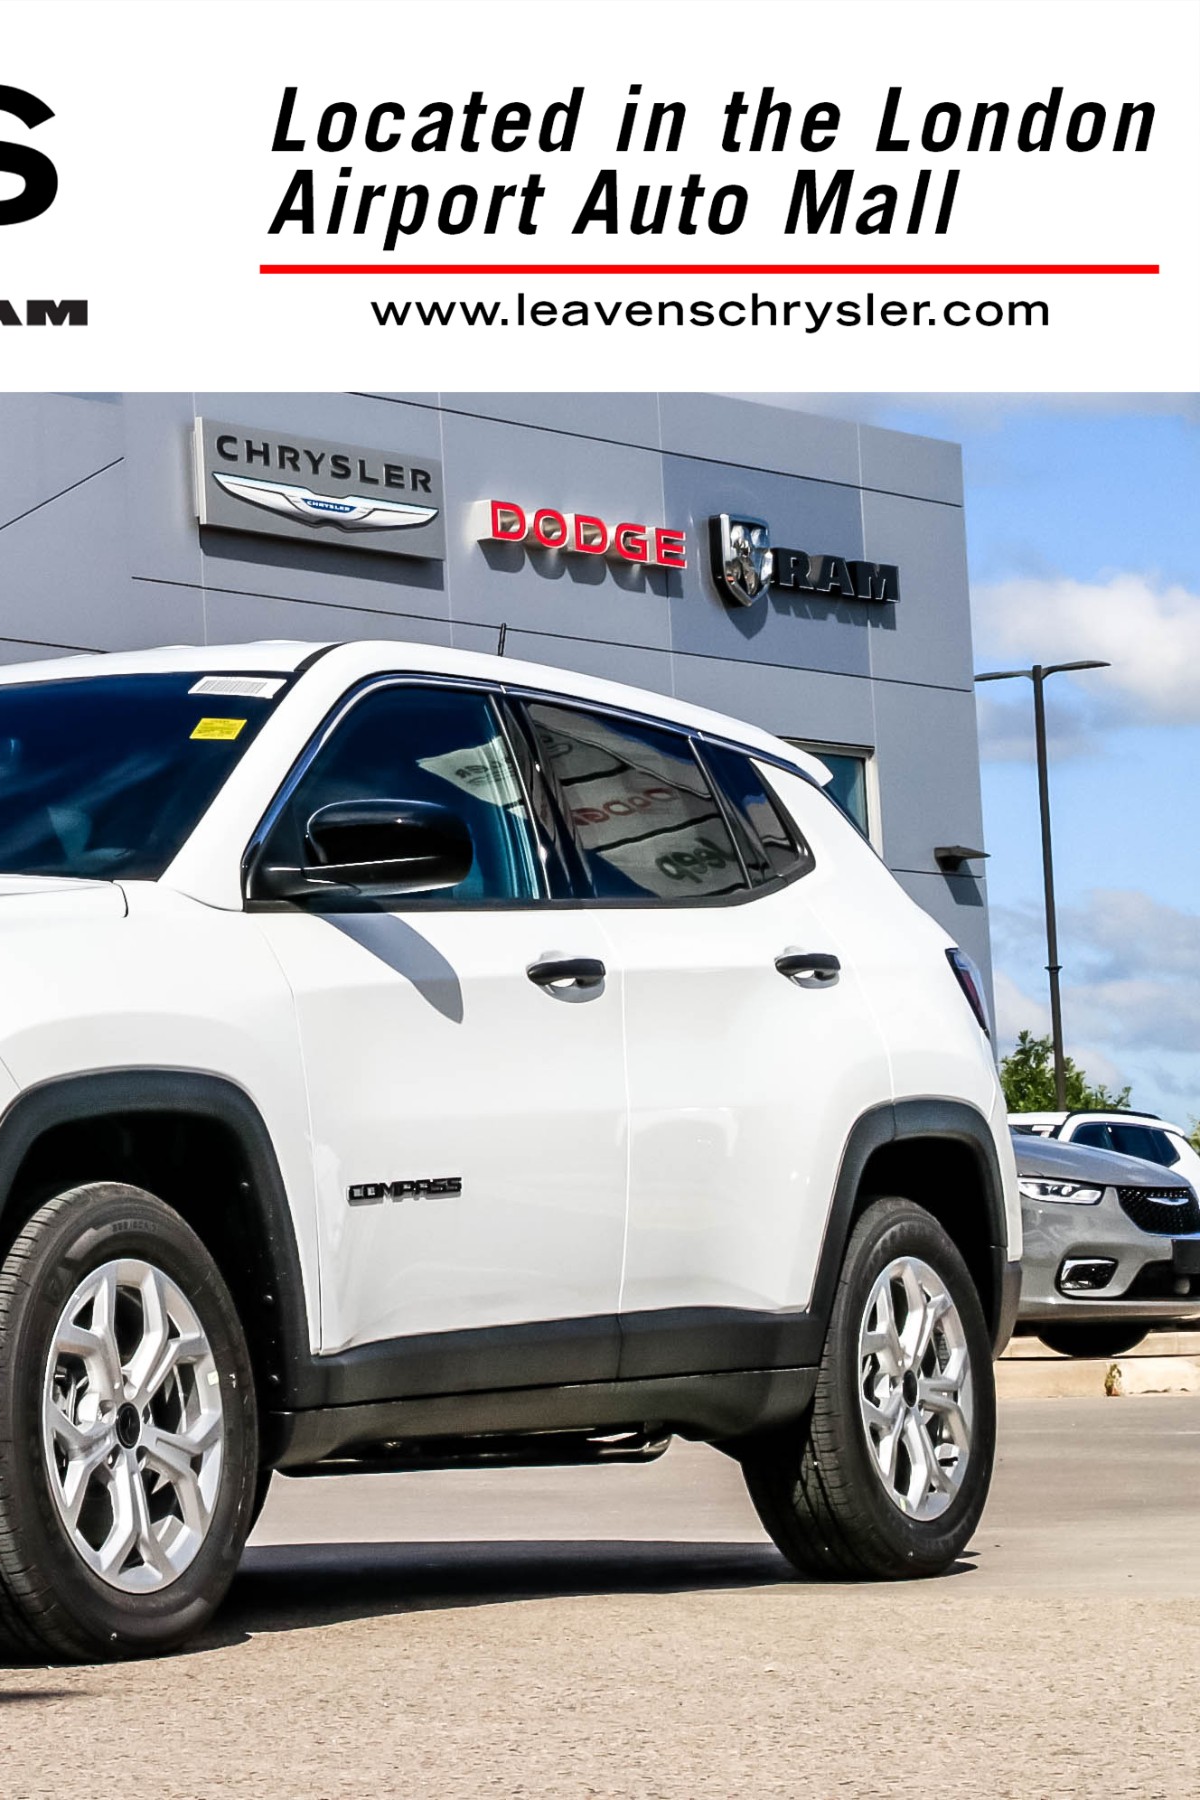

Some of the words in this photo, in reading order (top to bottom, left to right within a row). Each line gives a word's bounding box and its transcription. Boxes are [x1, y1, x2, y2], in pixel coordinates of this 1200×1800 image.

[216, 434, 433, 493] CHRYSLER
[306, 500, 351, 511] CHRYSLER
[490, 499, 688, 569] DODGE
[776, 547, 900, 603] RAM
[347, 1177, 462, 1203] COMPASS
